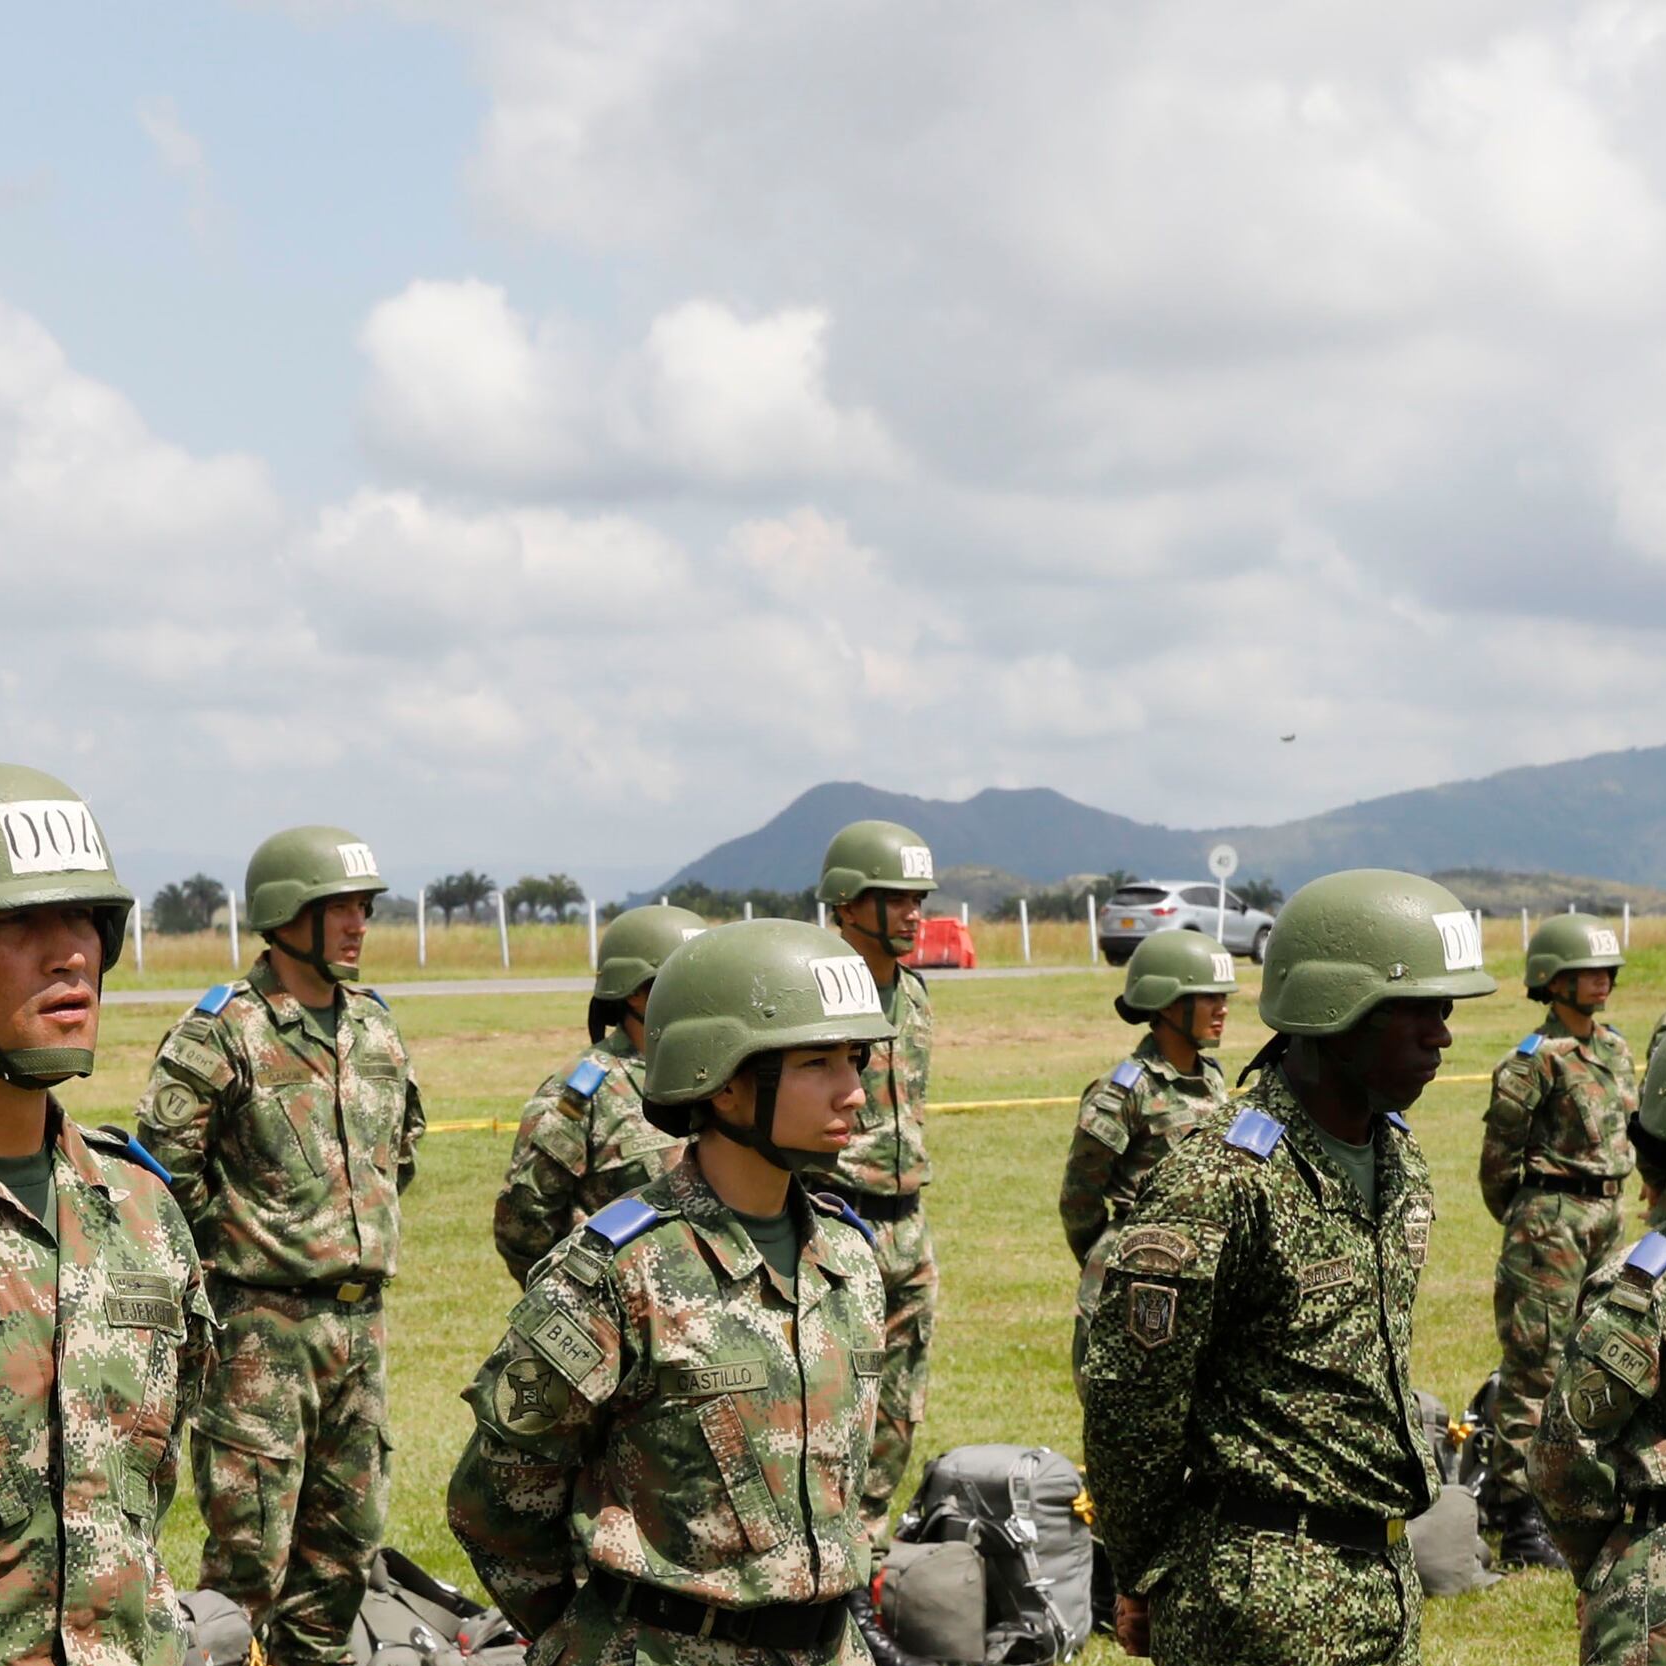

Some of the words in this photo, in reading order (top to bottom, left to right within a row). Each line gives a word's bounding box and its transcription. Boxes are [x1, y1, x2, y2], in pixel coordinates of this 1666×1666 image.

[3, 808, 102, 860] 004
[814, 961, 875, 1005] 007
[546, 1324, 563, 1341] B
[559, 1336, 590, 1361] RH+
[1608, 1344, 1619, 1358] O
[677, 1367, 752, 1391] CASTILLO
